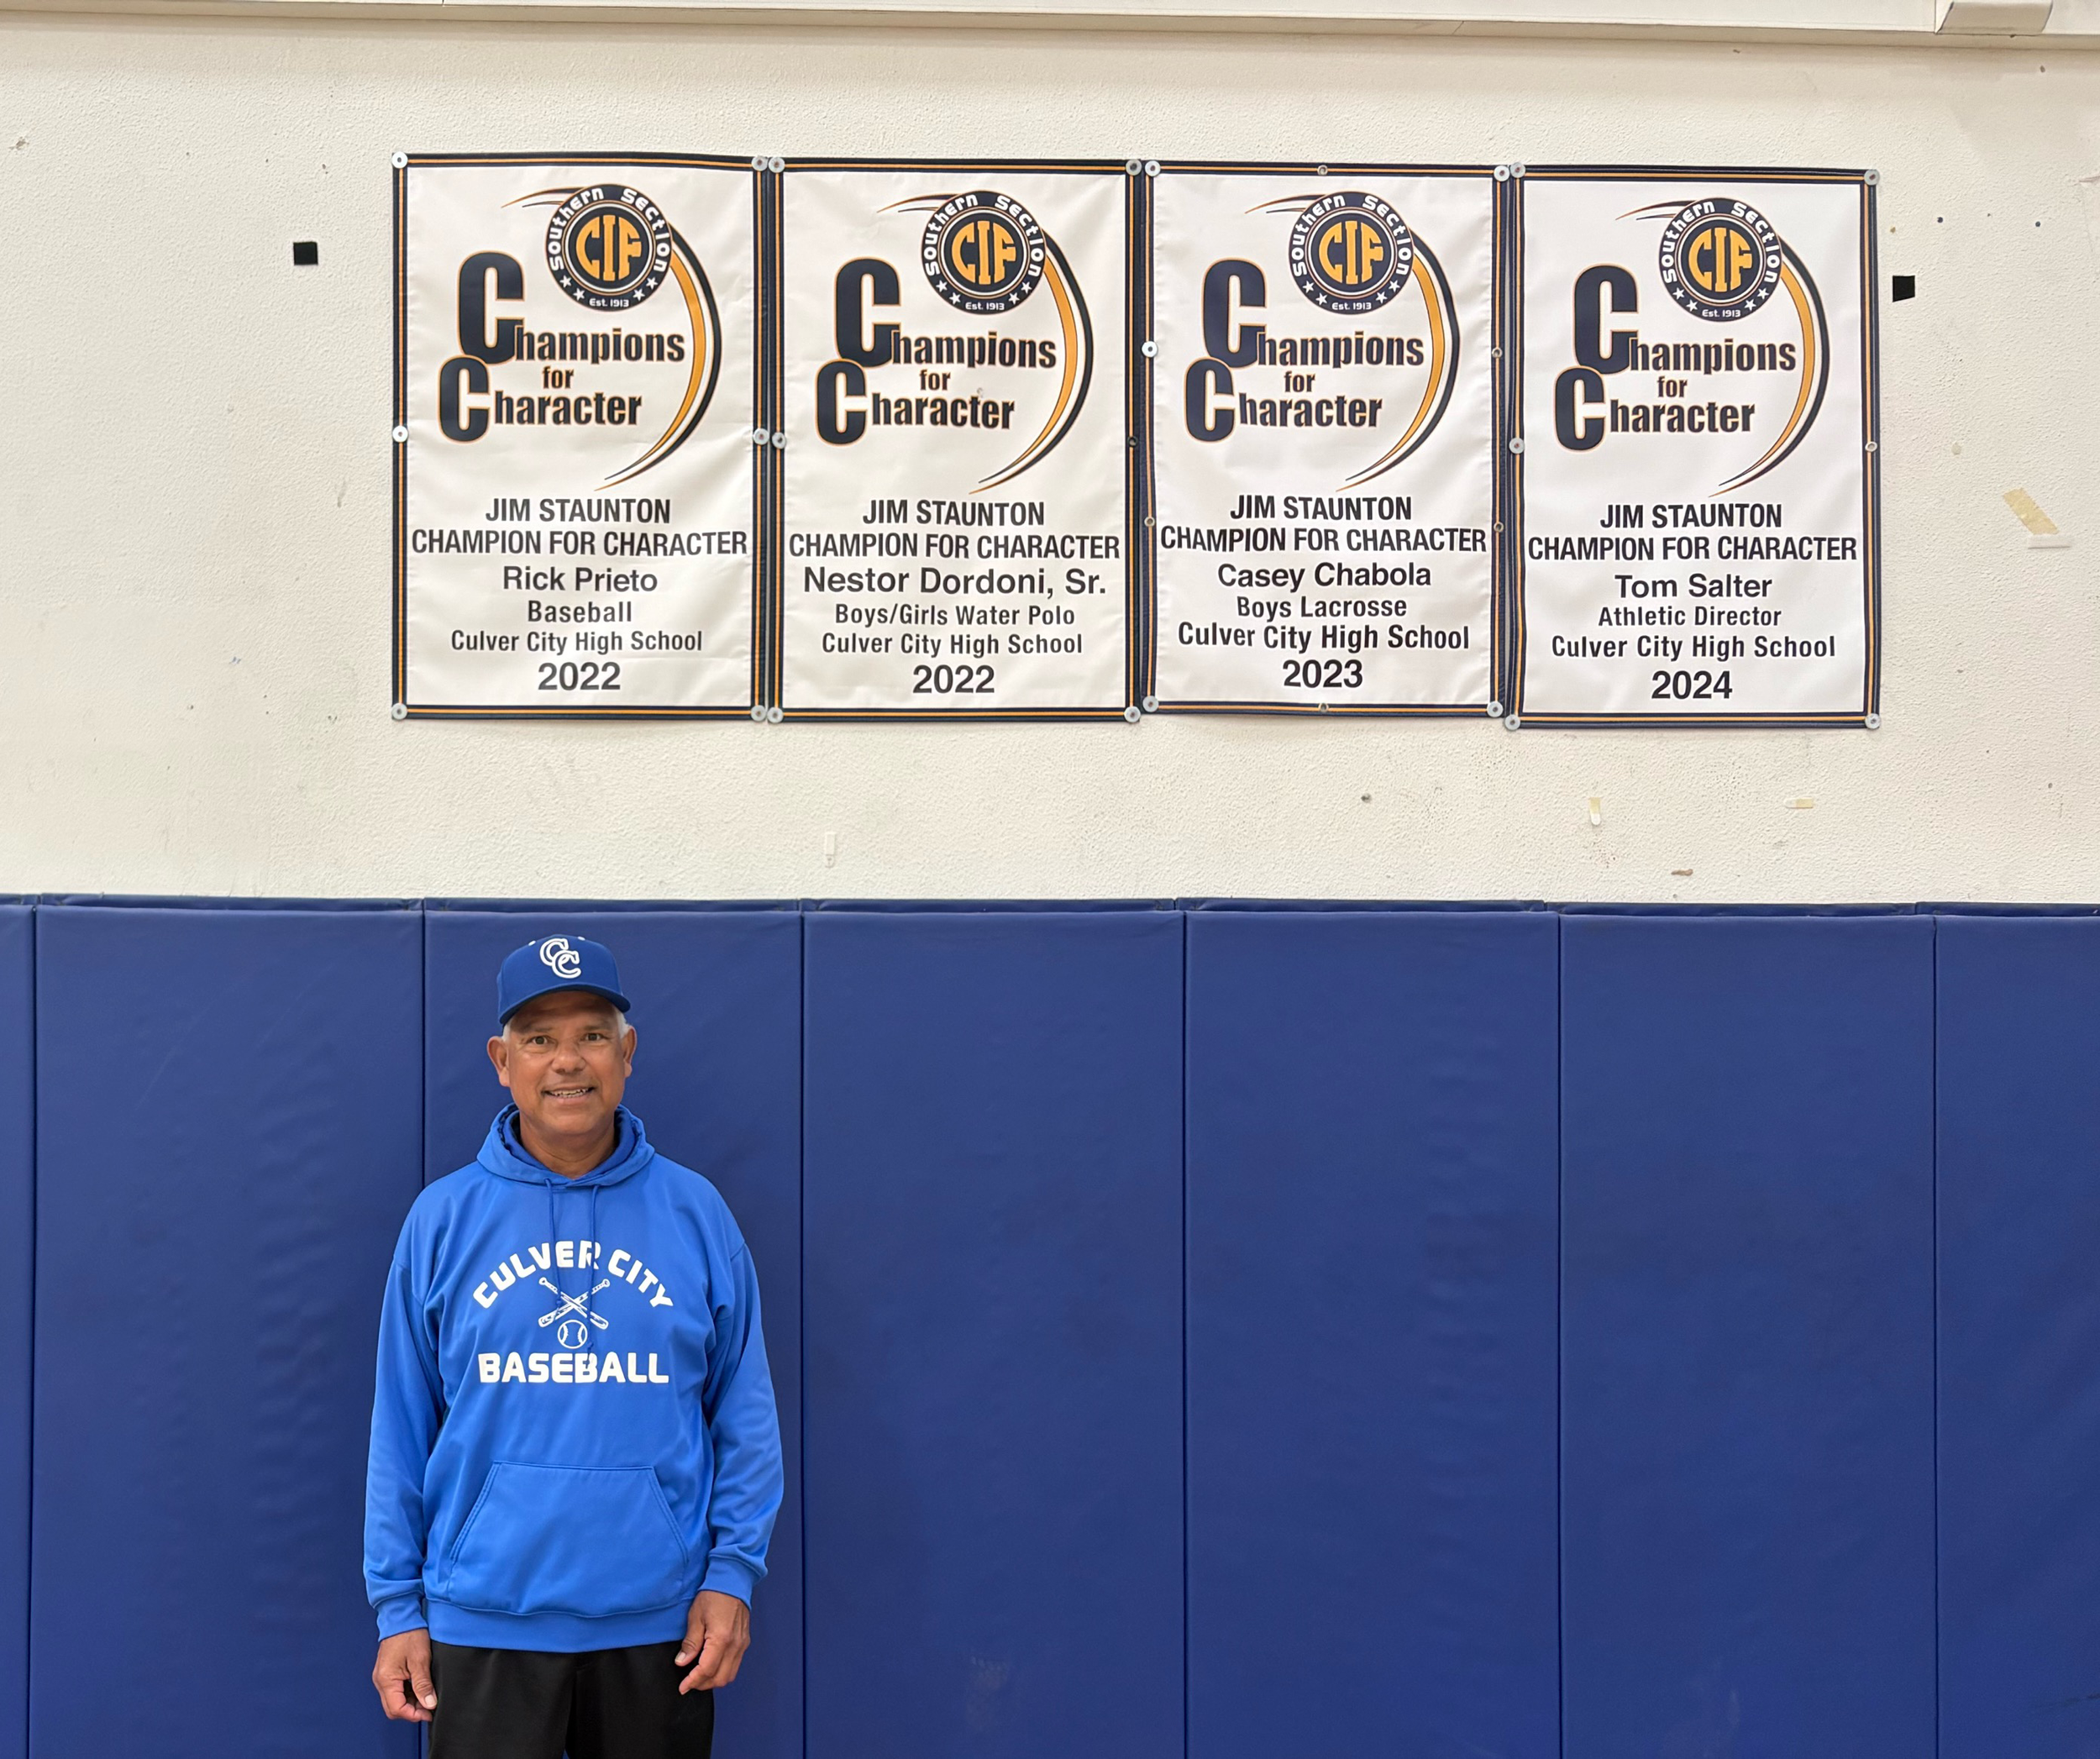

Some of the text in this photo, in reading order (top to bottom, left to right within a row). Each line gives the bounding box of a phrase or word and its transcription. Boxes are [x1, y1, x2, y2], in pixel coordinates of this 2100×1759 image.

[549, 188, 670, 272] Southern Section
[924, 194, 1044, 277] Southern Section
[1292, 195, 1411, 276] Southern Section
[1662, 202, 1780, 283] Southern Section
[576, 215, 642, 281] CIF
[952, 221, 1016, 285] CIF
[1319, 221, 1383, 285] CIF
[1688, 228, 1752, 292] CIF
[457, 250, 686, 365] Champions
[610, 299, 629, 307] 1913
[834, 256, 1057, 369] Champions
[1201, 258, 1425, 369] Champions
[1572, 263, 1797, 375] Champions
[543, 365, 575, 389] for
[919, 369, 951, 391] for
[1284, 371, 1315, 393] for
[1657, 375, 1688, 398] for
[438, 355, 643, 444] Character
[815, 359, 1015, 447] Character
[1184, 356, 1383, 444] Character
[1553, 365, 1756, 452] Character
[486, 498, 670, 524] JIM STAUNTON
[863, 499, 1044, 527] JIM STAUNTON
[1230, 494, 1411, 521] JIM STAUNTON
[1599, 503, 1782, 528] JIM STAUNTON
[412, 528, 747, 557] CHAMPION FOR CHARACTER
[789, 532, 1120, 559] CHAMPION FOR CHARACTER
[1161, 525, 1487, 553] CHAMPION FOR CHARACTER
[1528, 535, 1857, 561] CHAMPION FOR CHARACTER
[503, 565, 658, 592] Rick Prieto
[804, 566, 1105, 600] Nestor Dordoni, Sr.
[1218, 561, 1431, 593] Casey Chabola
[1614, 573, 1772, 598] Tom Salter
[528, 600, 632, 623] Baseball
[836, 603, 1074, 628] Boys/Girls Water Polo
[1236, 596, 1407, 623] Boys Lacrosse
[1598, 605, 1782, 627] Athletic Director
[451, 629, 702, 656] Culver City High School
[822, 633, 1082, 659] Culver City High School
[1179, 621, 1469, 654] Culver City High School
[1551, 635, 1835, 662] Culver City High School
[538, 661, 621, 690] 2022
[912, 664, 995, 694] 2022
[1283, 659, 1363, 689] 2023
[1651, 670, 1733, 700] 2024
[473, 1240, 674, 1309] CULVER CITY
[478, 1352, 669, 1384] BASEBALL
